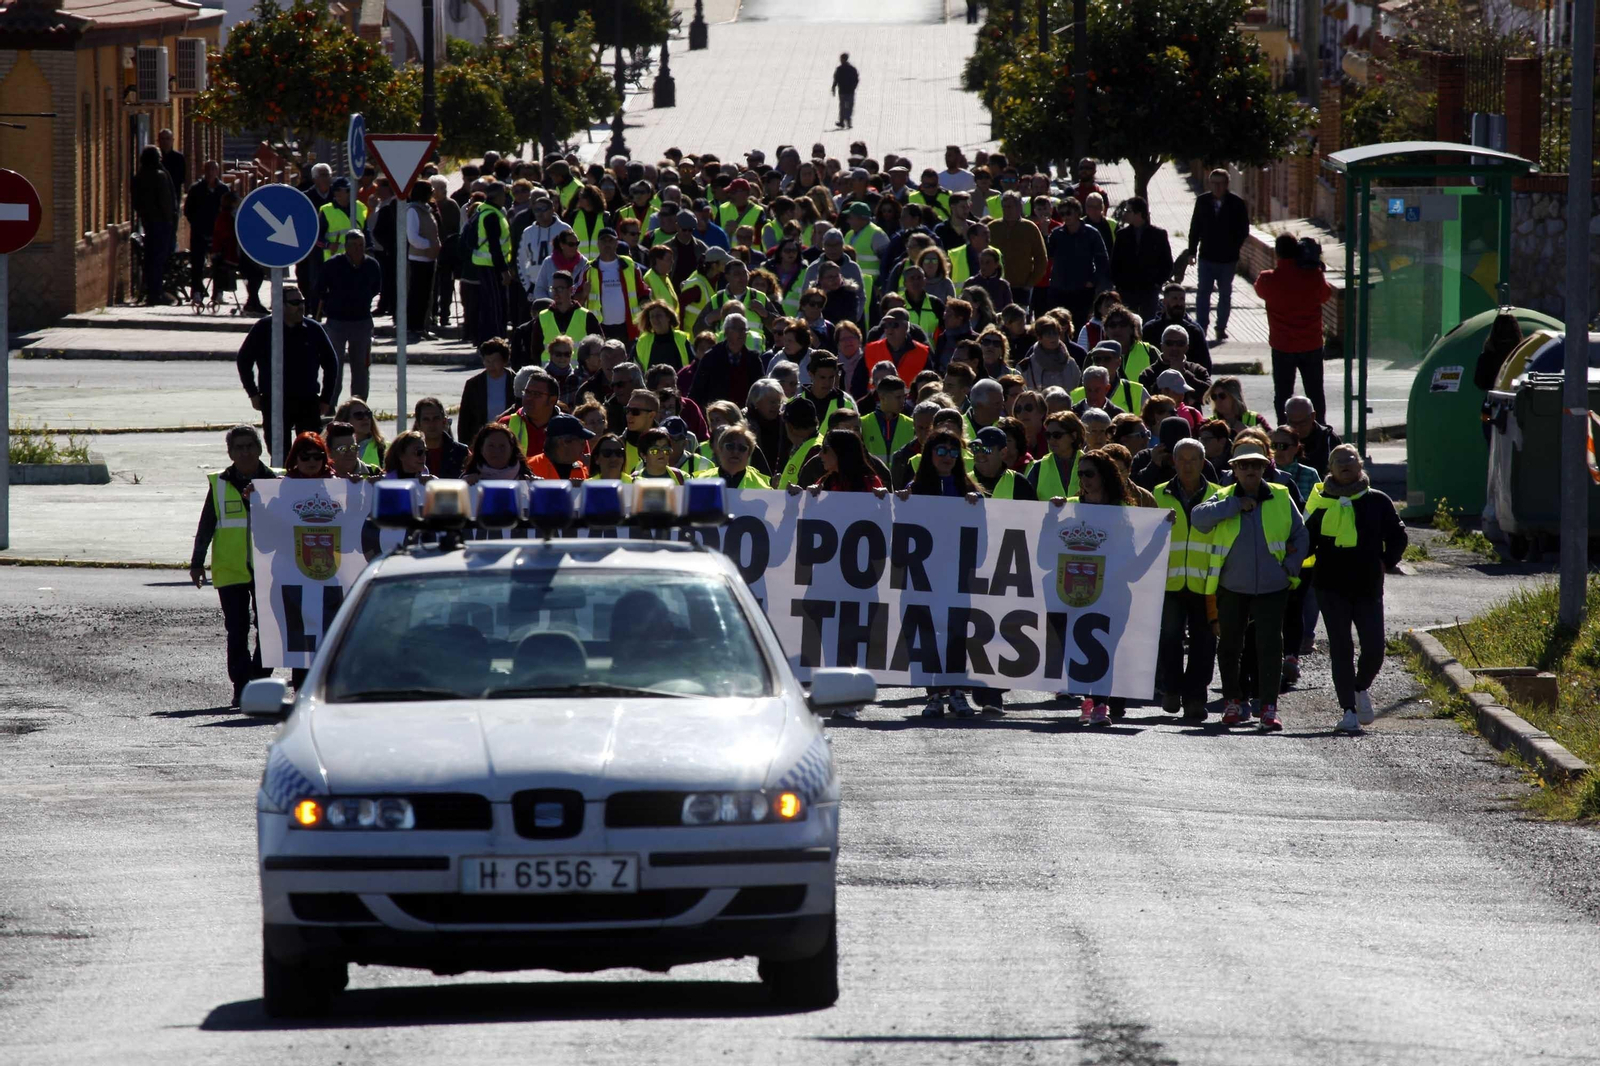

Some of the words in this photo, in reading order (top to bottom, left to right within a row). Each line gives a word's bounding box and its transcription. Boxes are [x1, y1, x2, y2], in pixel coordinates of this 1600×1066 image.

[794, 518, 933, 592] POR
[958, 526, 1035, 598] LA
[790, 599, 1111, 684] THARSIS
[479, 861, 497, 889] H
[514, 860, 593, 888] 6556
[611, 859, 628, 888] Z
